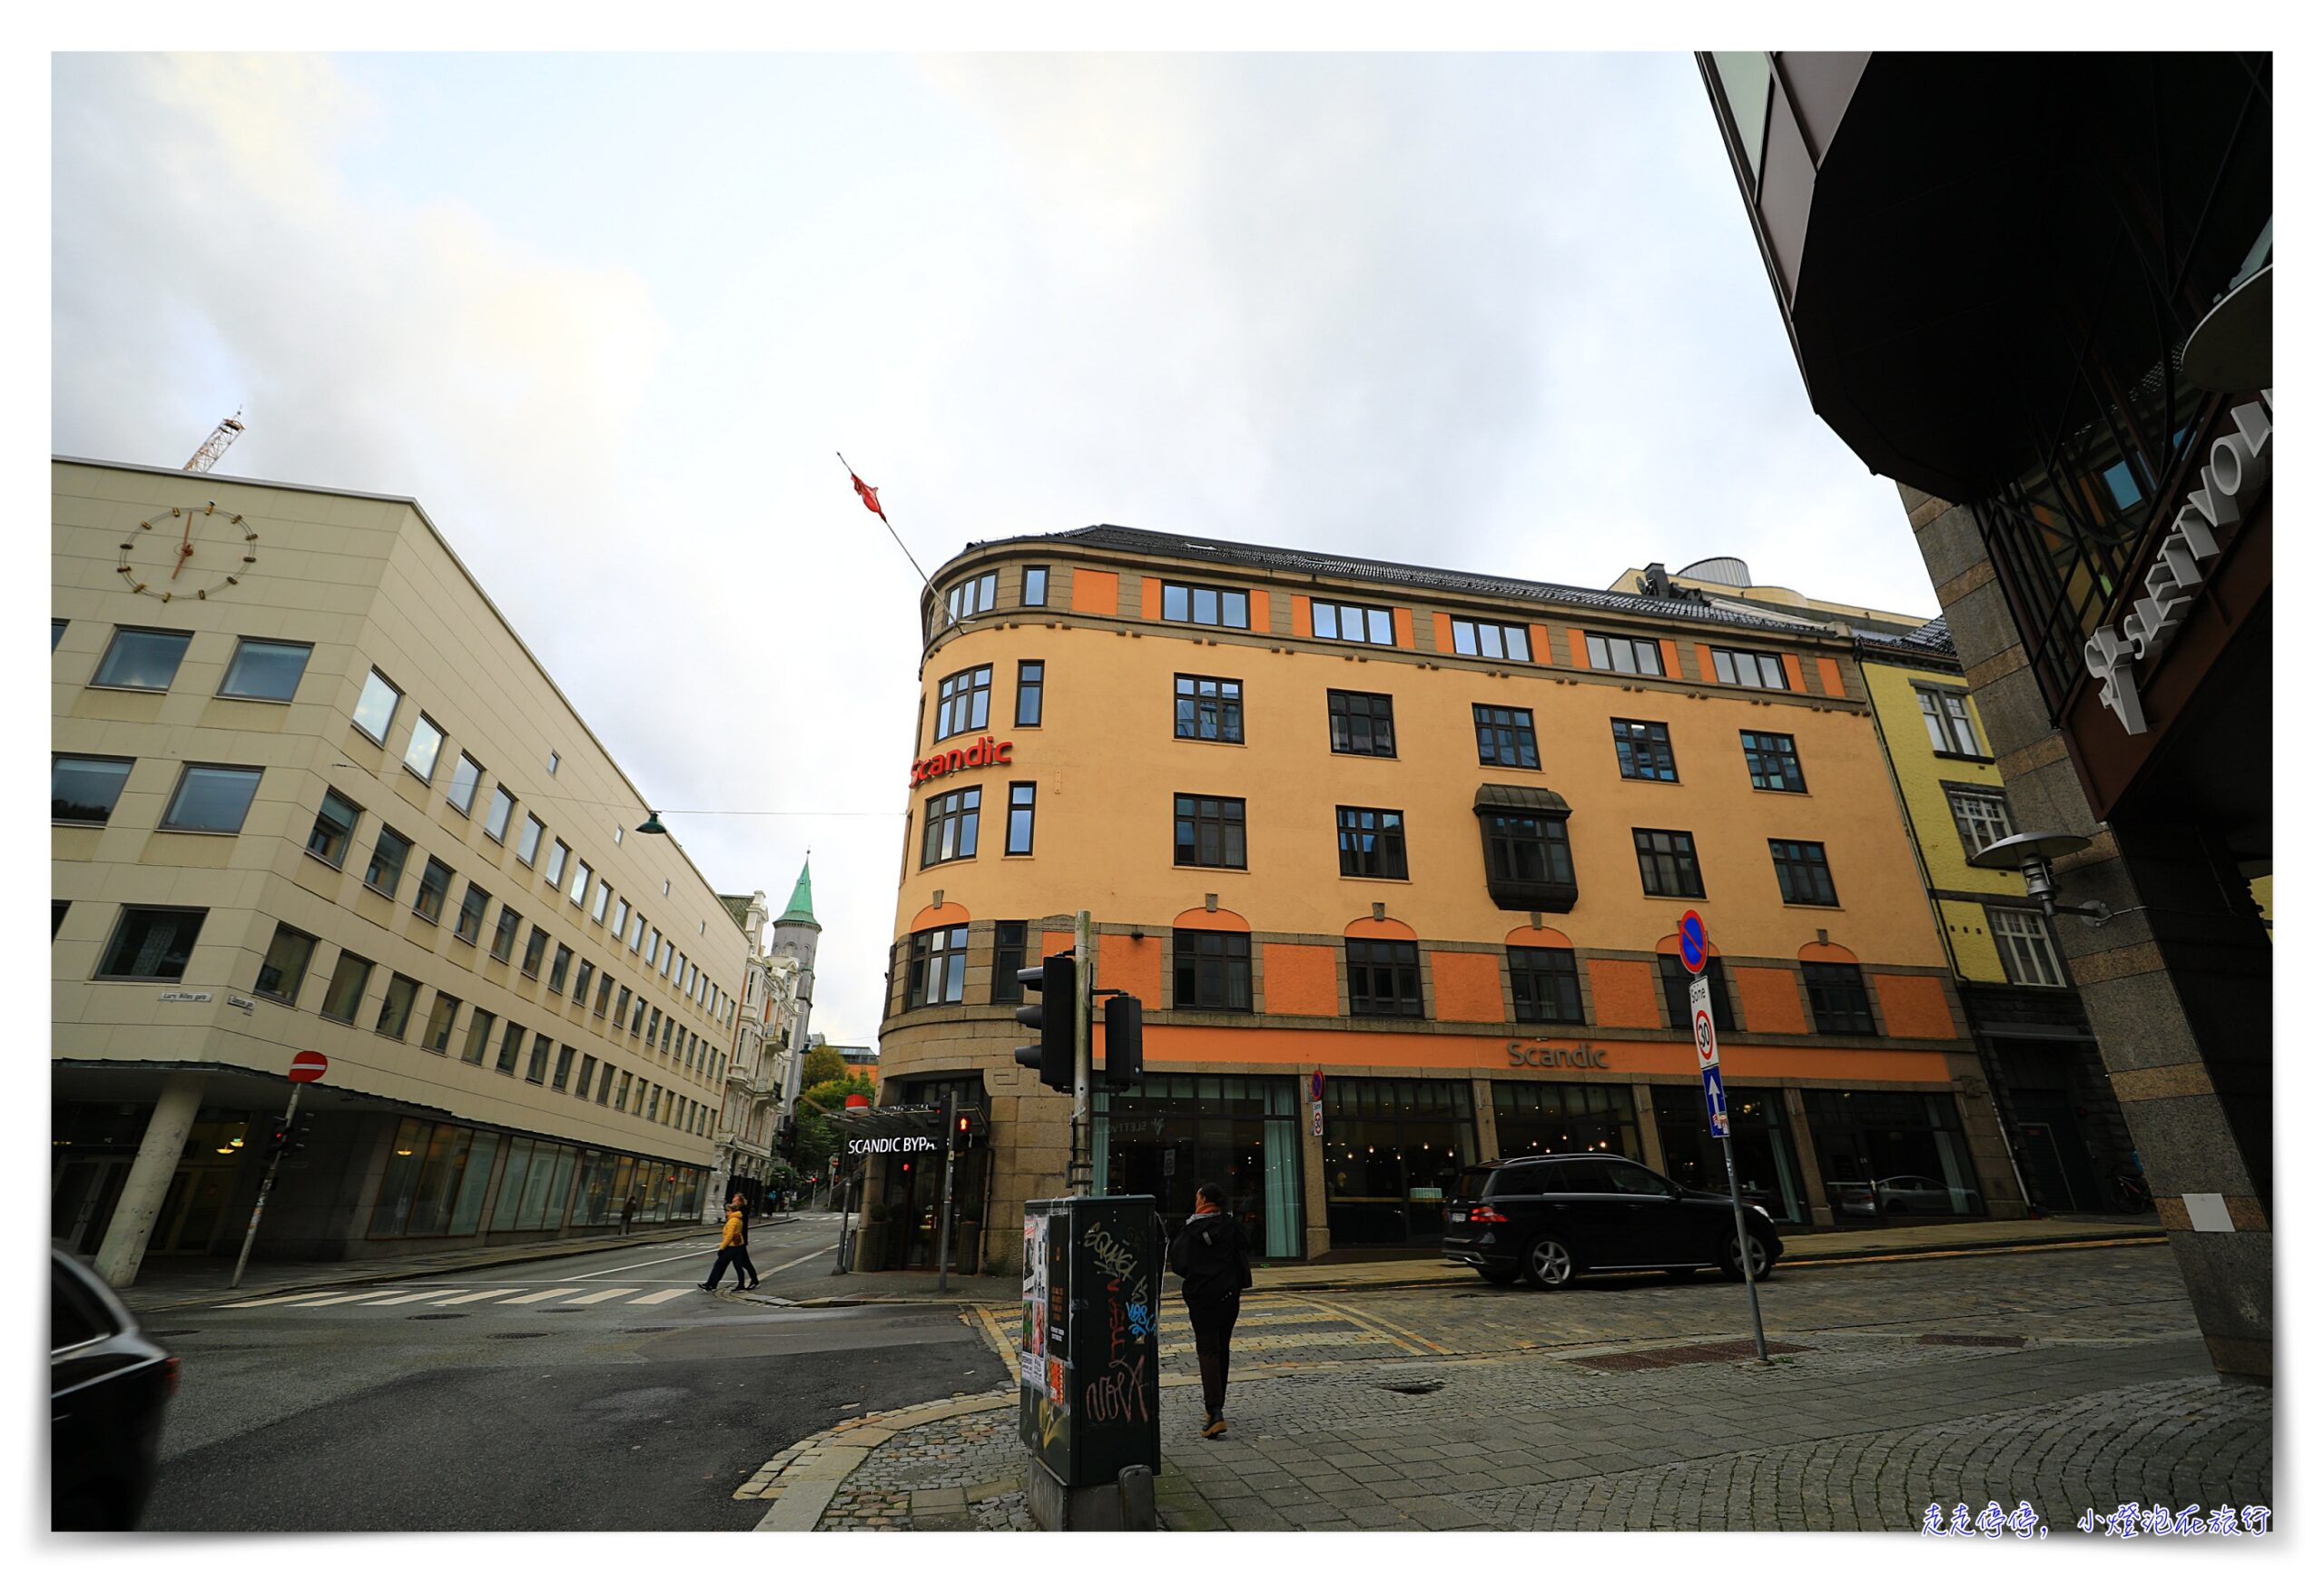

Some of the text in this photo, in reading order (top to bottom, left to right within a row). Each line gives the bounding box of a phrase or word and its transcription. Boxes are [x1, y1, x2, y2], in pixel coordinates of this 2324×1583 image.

[2123, 390, 2273, 661] SLETTVOL
[909, 736, 1014, 790] Scandic
[1690, 986, 1706, 1004] Sone
[1699, 1021, 1710, 1047] 30
[1507, 1040, 1611, 1069] Scandic
[848, 1136, 950, 1155] SCANDIC BYPA
